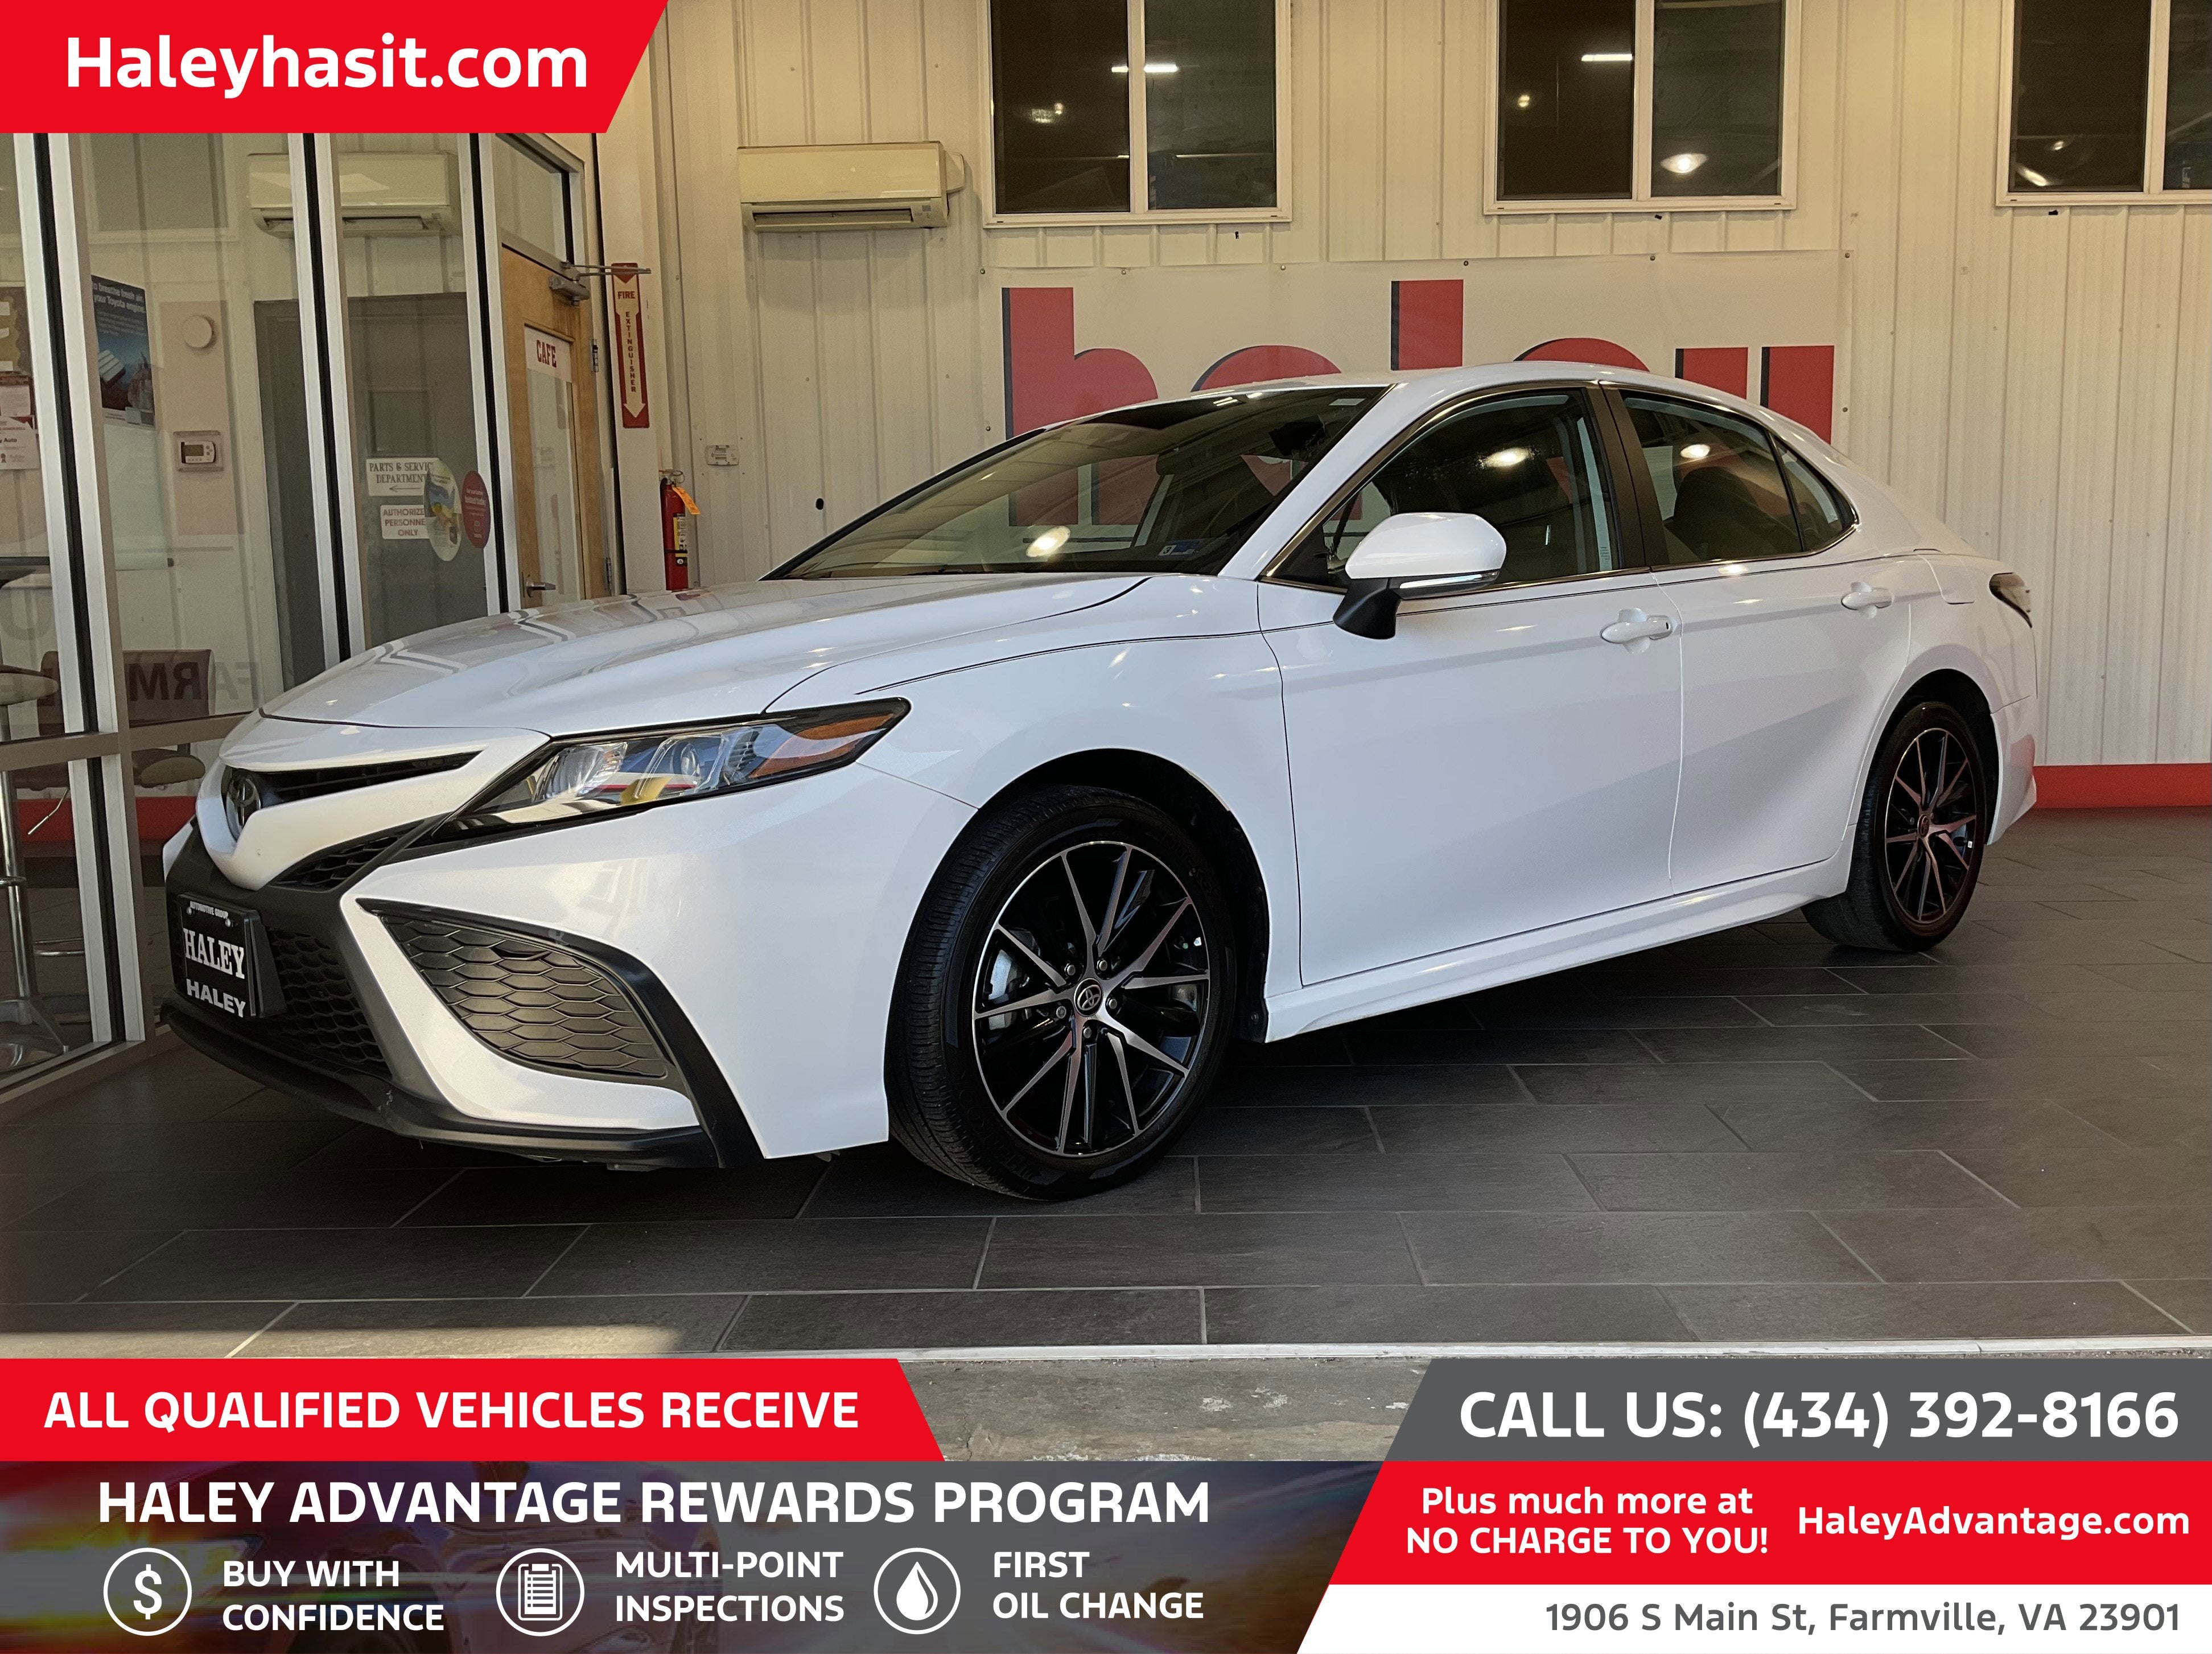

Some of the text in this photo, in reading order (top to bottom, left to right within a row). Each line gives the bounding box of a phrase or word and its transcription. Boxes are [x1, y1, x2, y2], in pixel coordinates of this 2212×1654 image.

[106, 295, 126, 308] Toyota
[617, 291, 635, 299] FIRE
[536, 339, 557, 368] CAFE
[625, 311, 636, 392] EXTINGUISHER
[369, 462, 433, 472] PARTS & SERVIC
[382, 508, 425, 517] AUTHORIZE
[183, 928, 245, 980] HALEY
[186, 978, 246, 1018] HALEY
